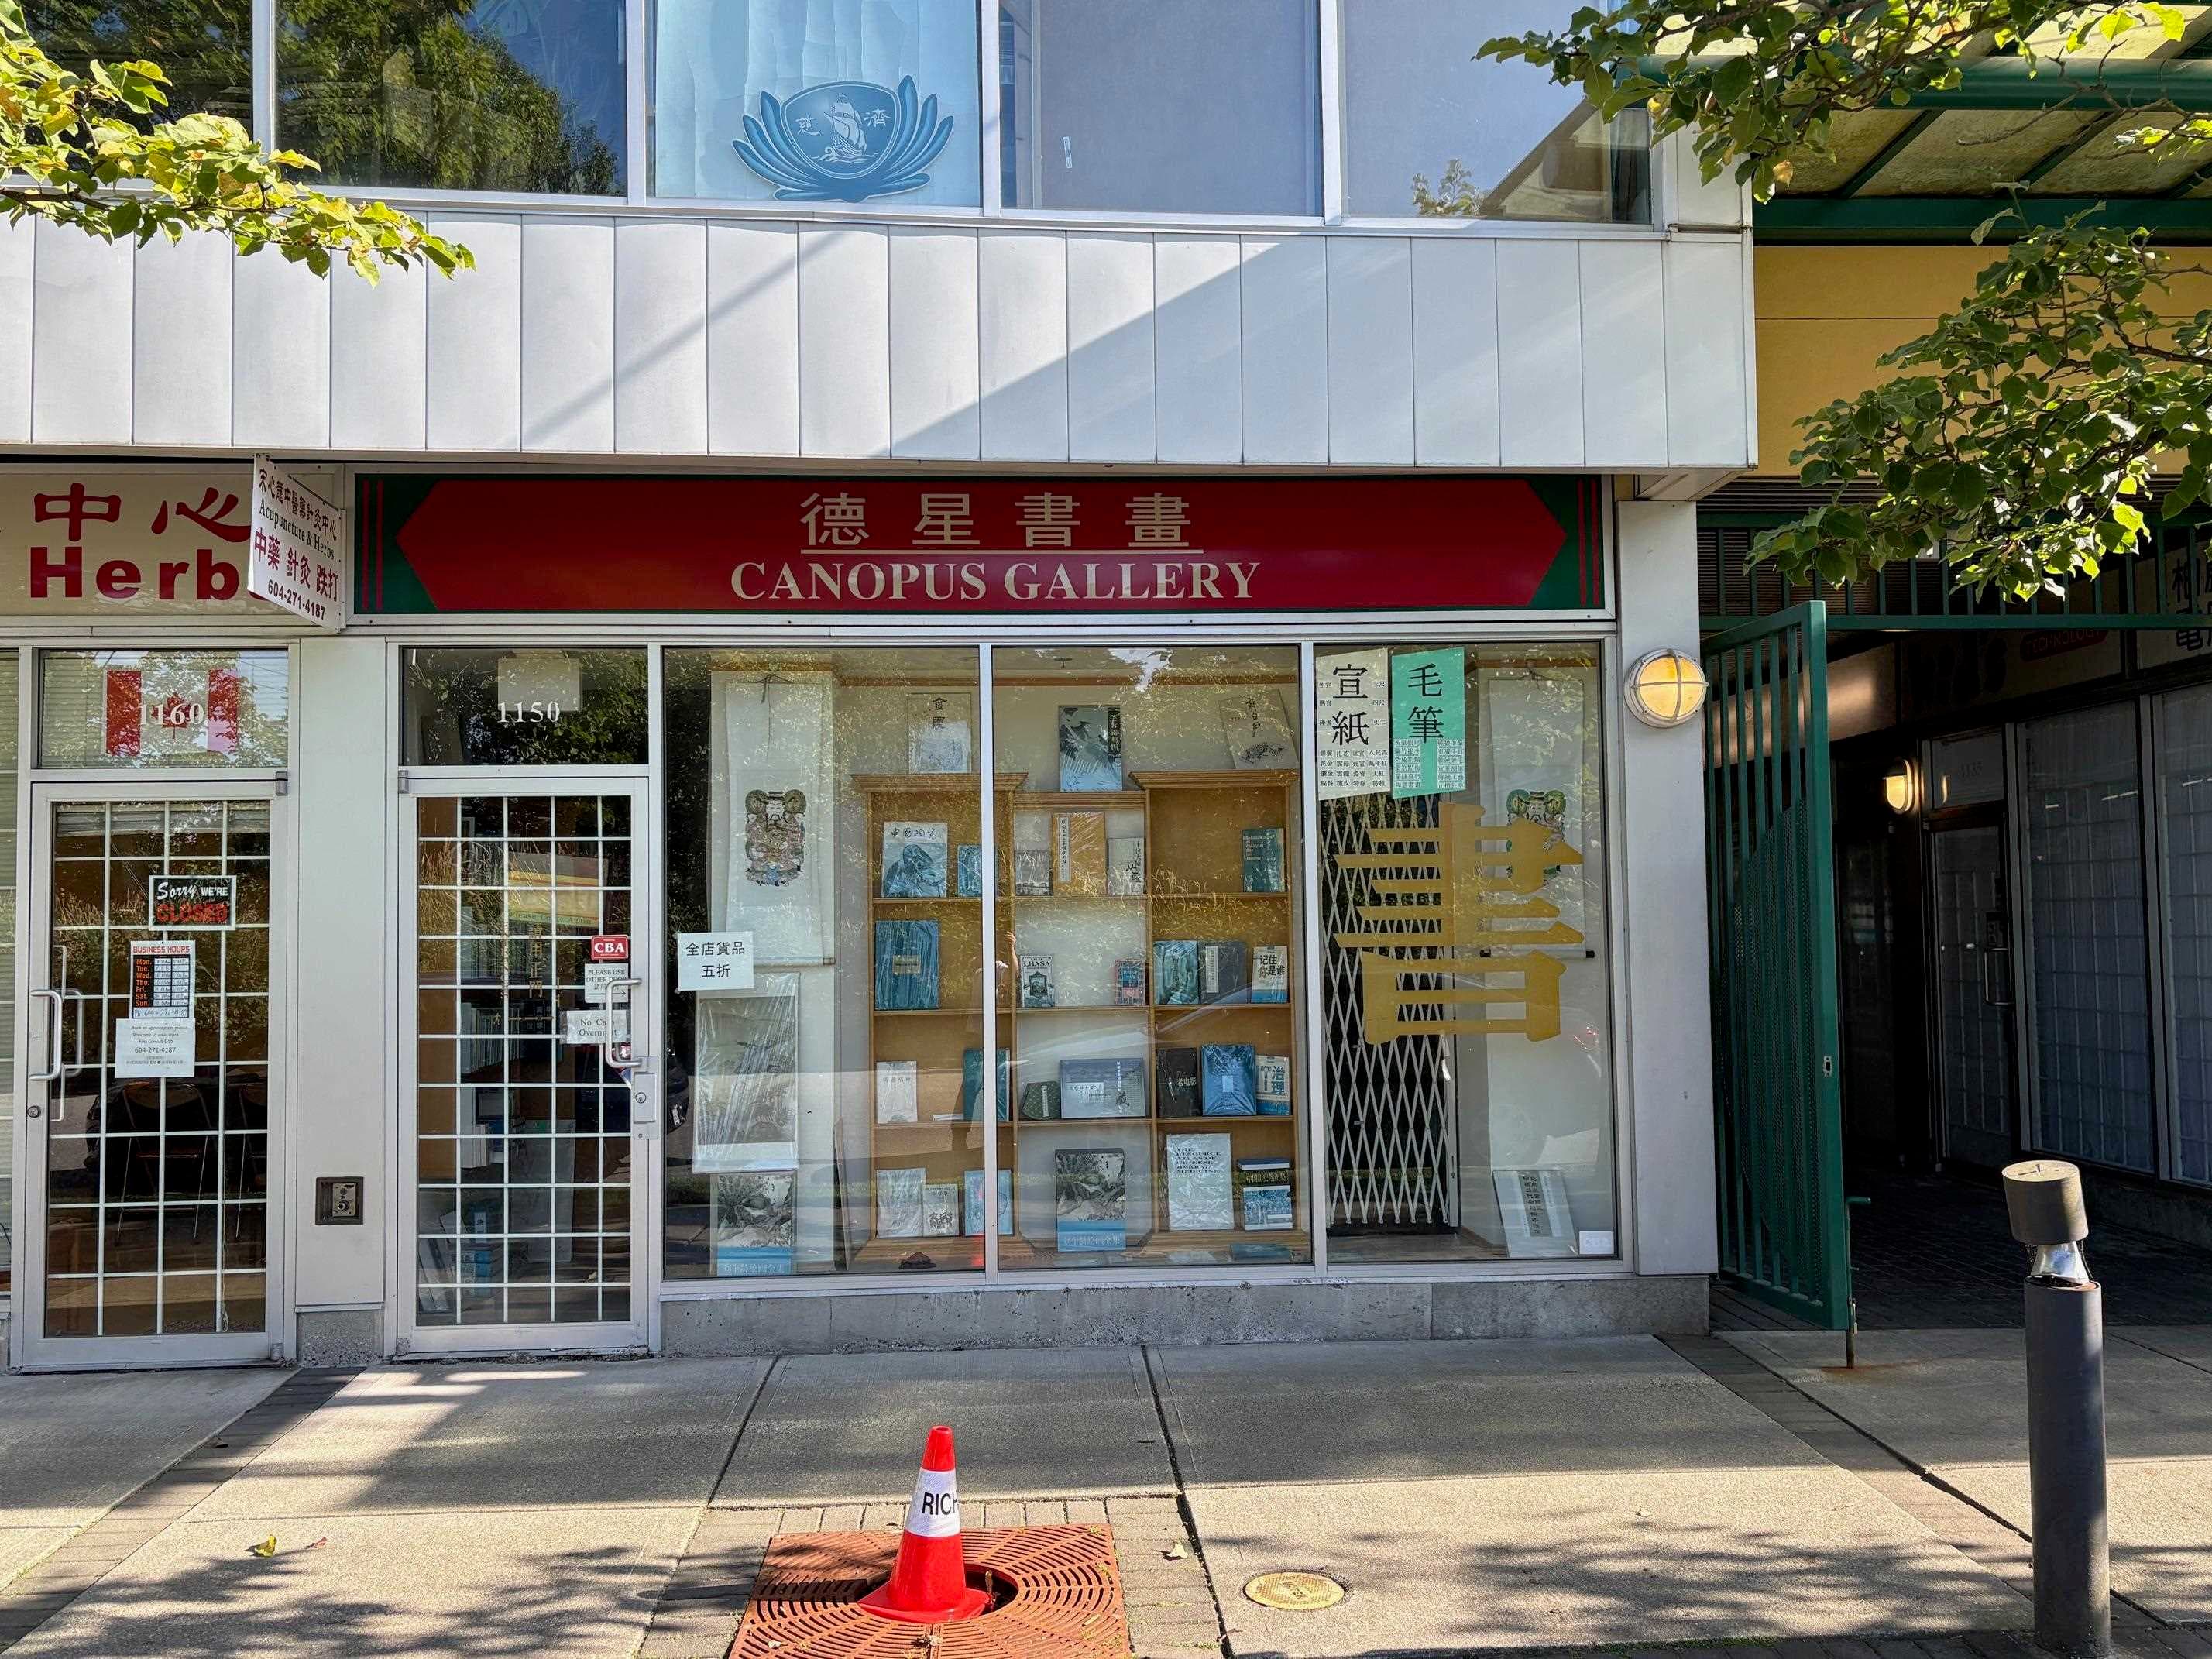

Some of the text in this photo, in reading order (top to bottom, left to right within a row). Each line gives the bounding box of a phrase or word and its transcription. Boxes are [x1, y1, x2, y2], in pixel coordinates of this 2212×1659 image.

[34, 483, 252, 542] 中心
[259, 498, 335, 560] Acupuncture & Herbs
[799, 492, 1192, 548] 德星書畫
[30, 546, 269, 601] Herb
[254, 527, 339, 602] 中藥 針灸 跌打
[730, 562, 1261, 601] CANOPUS GALLERY
[268, 579, 326, 620] 604-271-4187
[138, 702, 205, 726] 1160
[496, 701, 561, 723] 1150
[1332, 663, 1369, 746] 宣紙
[1407, 663, 1444, 744] 毛筆
[156, 881, 228, 900] Sorry WE'RE
[156, 903, 228, 923] CLOSED
[1333, 801, 1585, 1046] 書
[133, 946, 166, 954] BUSINESS
[594, 943, 625, 953] CBA
[685, 941, 745, 957] 全店貨品
[701, 964, 731, 978] 五折
